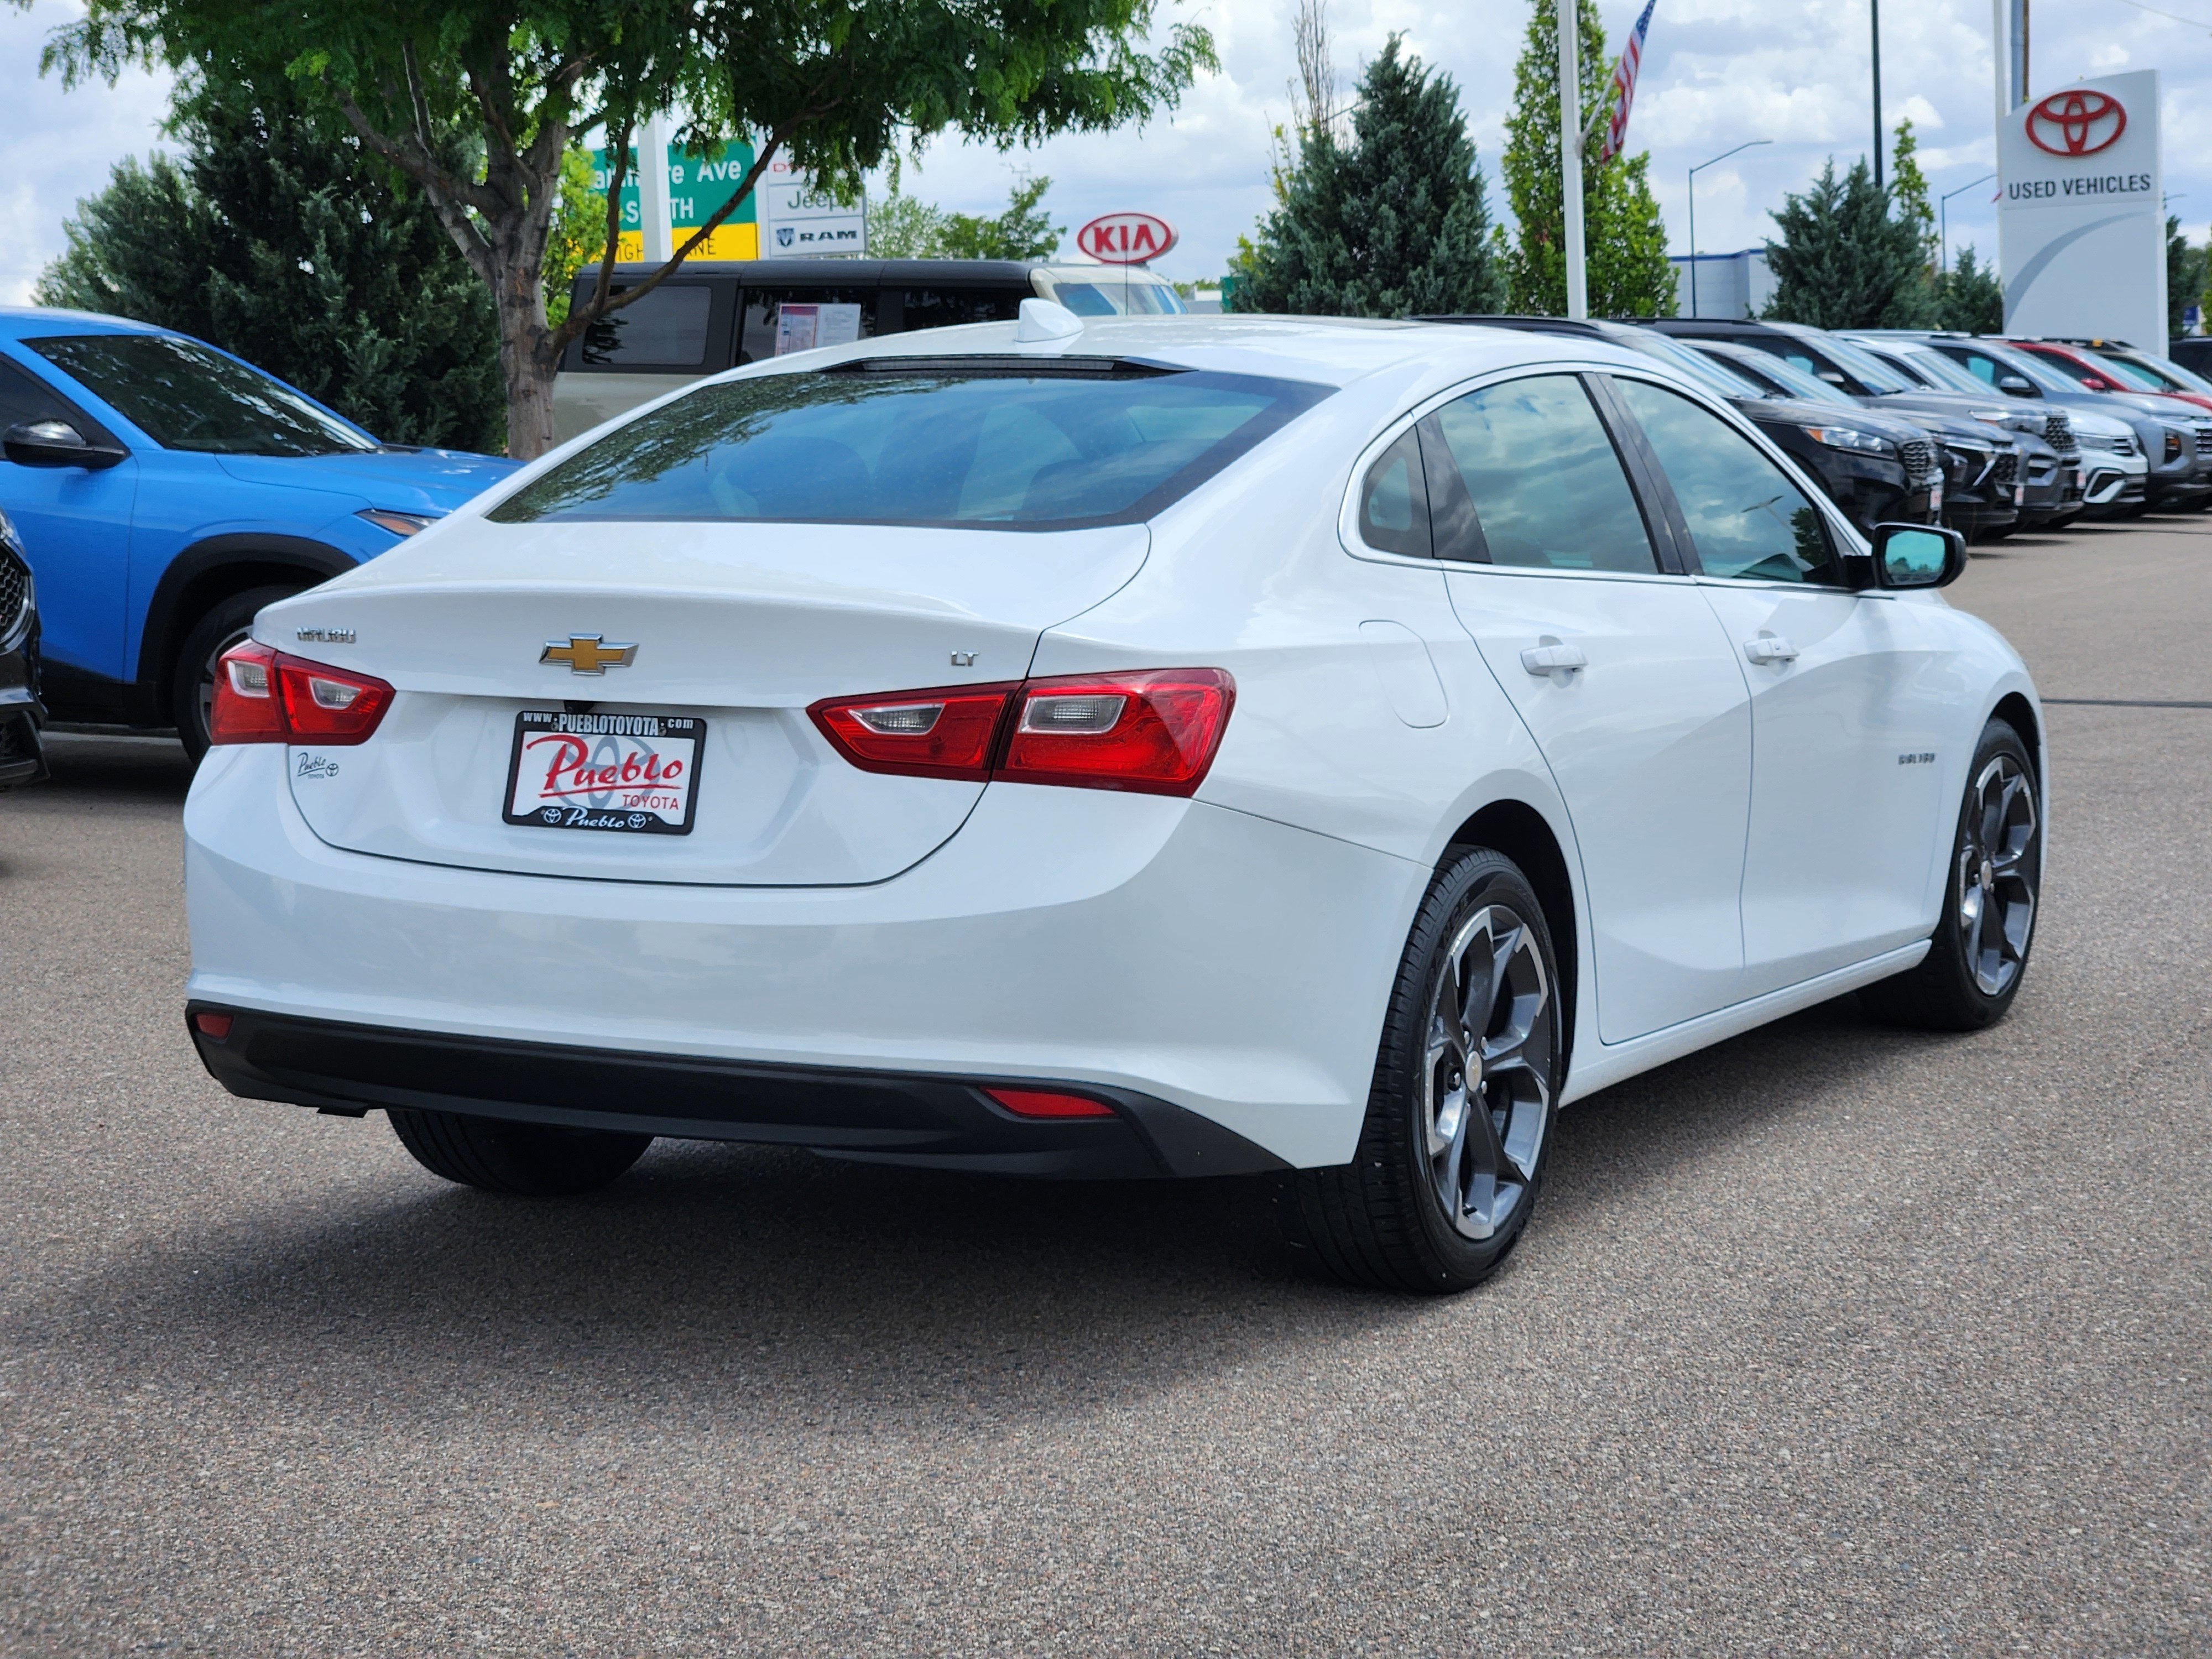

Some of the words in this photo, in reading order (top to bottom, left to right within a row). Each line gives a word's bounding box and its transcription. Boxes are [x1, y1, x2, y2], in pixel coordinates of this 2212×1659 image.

[697, 159, 742, 182] Ave
[2009, 180, 2056, 200] USED
[2063, 174, 2151, 196] VEHICLES
[625, 197, 694, 224] STH
[800, 231, 857, 242] RAM
[1093, 224, 1156, 253] KIA
[951, 650, 979, 667] LT
[526, 734, 683, 790] Pueblo
[623, 794, 679, 810] TOYOTA
[562, 806, 625, 827] Pueblo
